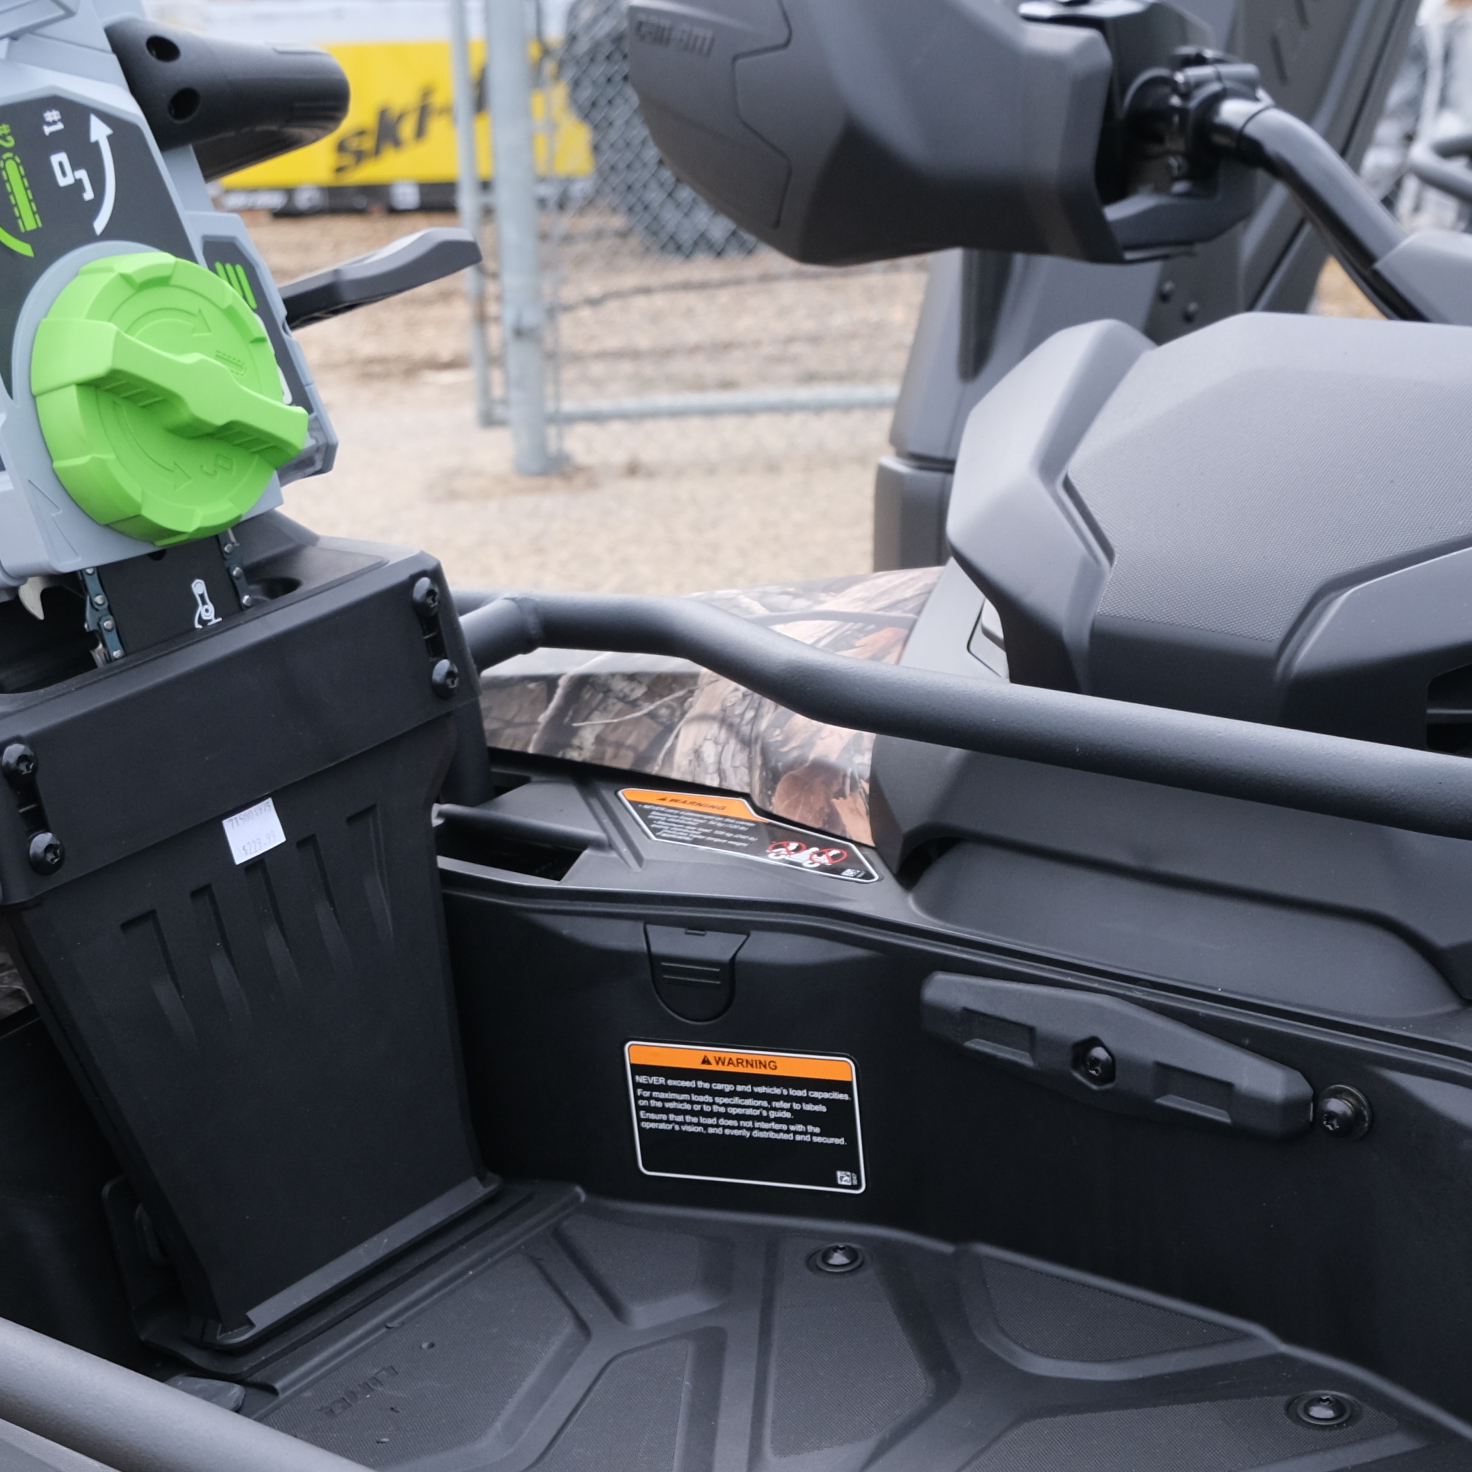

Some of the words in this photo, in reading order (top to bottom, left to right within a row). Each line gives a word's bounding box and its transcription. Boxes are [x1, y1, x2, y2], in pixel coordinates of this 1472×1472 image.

[42, 108, 65, 136] #1
[669, 797, 727, 811] WARNING
[713, 1055, 778, 1072] WARNING
[635, 1076, 665, 1085] NEVER
[667, 1079, 696, 1087] exceed
[697, 1081, 710, 1089] the
[712, 1083, 735, 1092] cargo
[736, 1084, 752, 1092] and
[753, 1086, 788, 1095] vehicle's
[789, 1088, 807, 1096] load
[809, 1091, 851, 1100] capacities.
[637, 1089, 651, 1097] For
[652, 1092, 690, 1101] maximum
[691, 1094, 713, 1102] loads
[793, 1102, 800, 1110] to
[802, 1103, 827, 1112] labels
[664, 1102, 691, 1110] vehicle
[713, 1105, 725, 1113] the
[727, 1106, 767, 1116] operator's
[769, 1110, 794, 1118] guide.
[639, 1111, 667, 1120] Ensure
[669, 1113, 684, 1121] that
[685, 1115, 698, 1123] the
[700, 1116, 717, 1124] load
[719, 1118, 738, 1126] does
[755, 1120, 788, 1131] interfere
[789, 1124, 806, 1132] with
[807, 1125, 820, 1133] the
[641, 1121, 680, 1131] operator's
[681, 1124, 706, 1133] vision,
[724, 1129, 751, 1138] evenly
[752, 1130, 793, 1140] distributed
[795, 1134, 811, 1142] and
[812, 1136, 847, 1145] secured.
